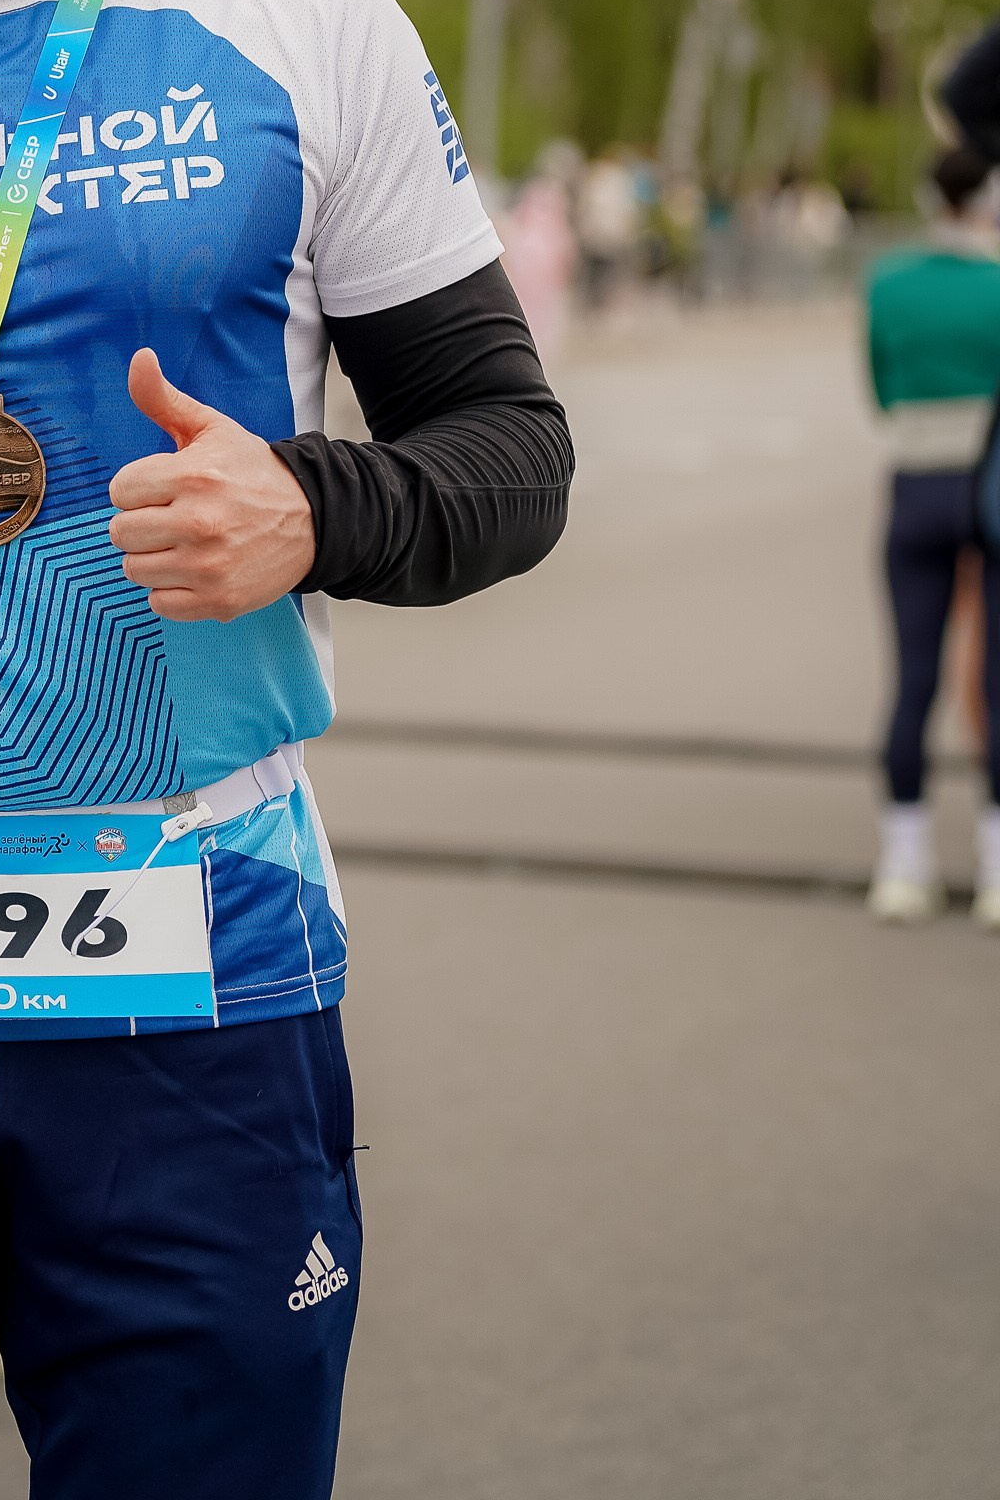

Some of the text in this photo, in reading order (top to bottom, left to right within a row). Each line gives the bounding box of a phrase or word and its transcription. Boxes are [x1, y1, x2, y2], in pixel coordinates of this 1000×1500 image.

[49, 48, 71, 80] Utair
[16, 135, 41, 181] СБЕР
[1, 833, 48, 844] зелёный
[288, 1267, 349, 1312] adidas
